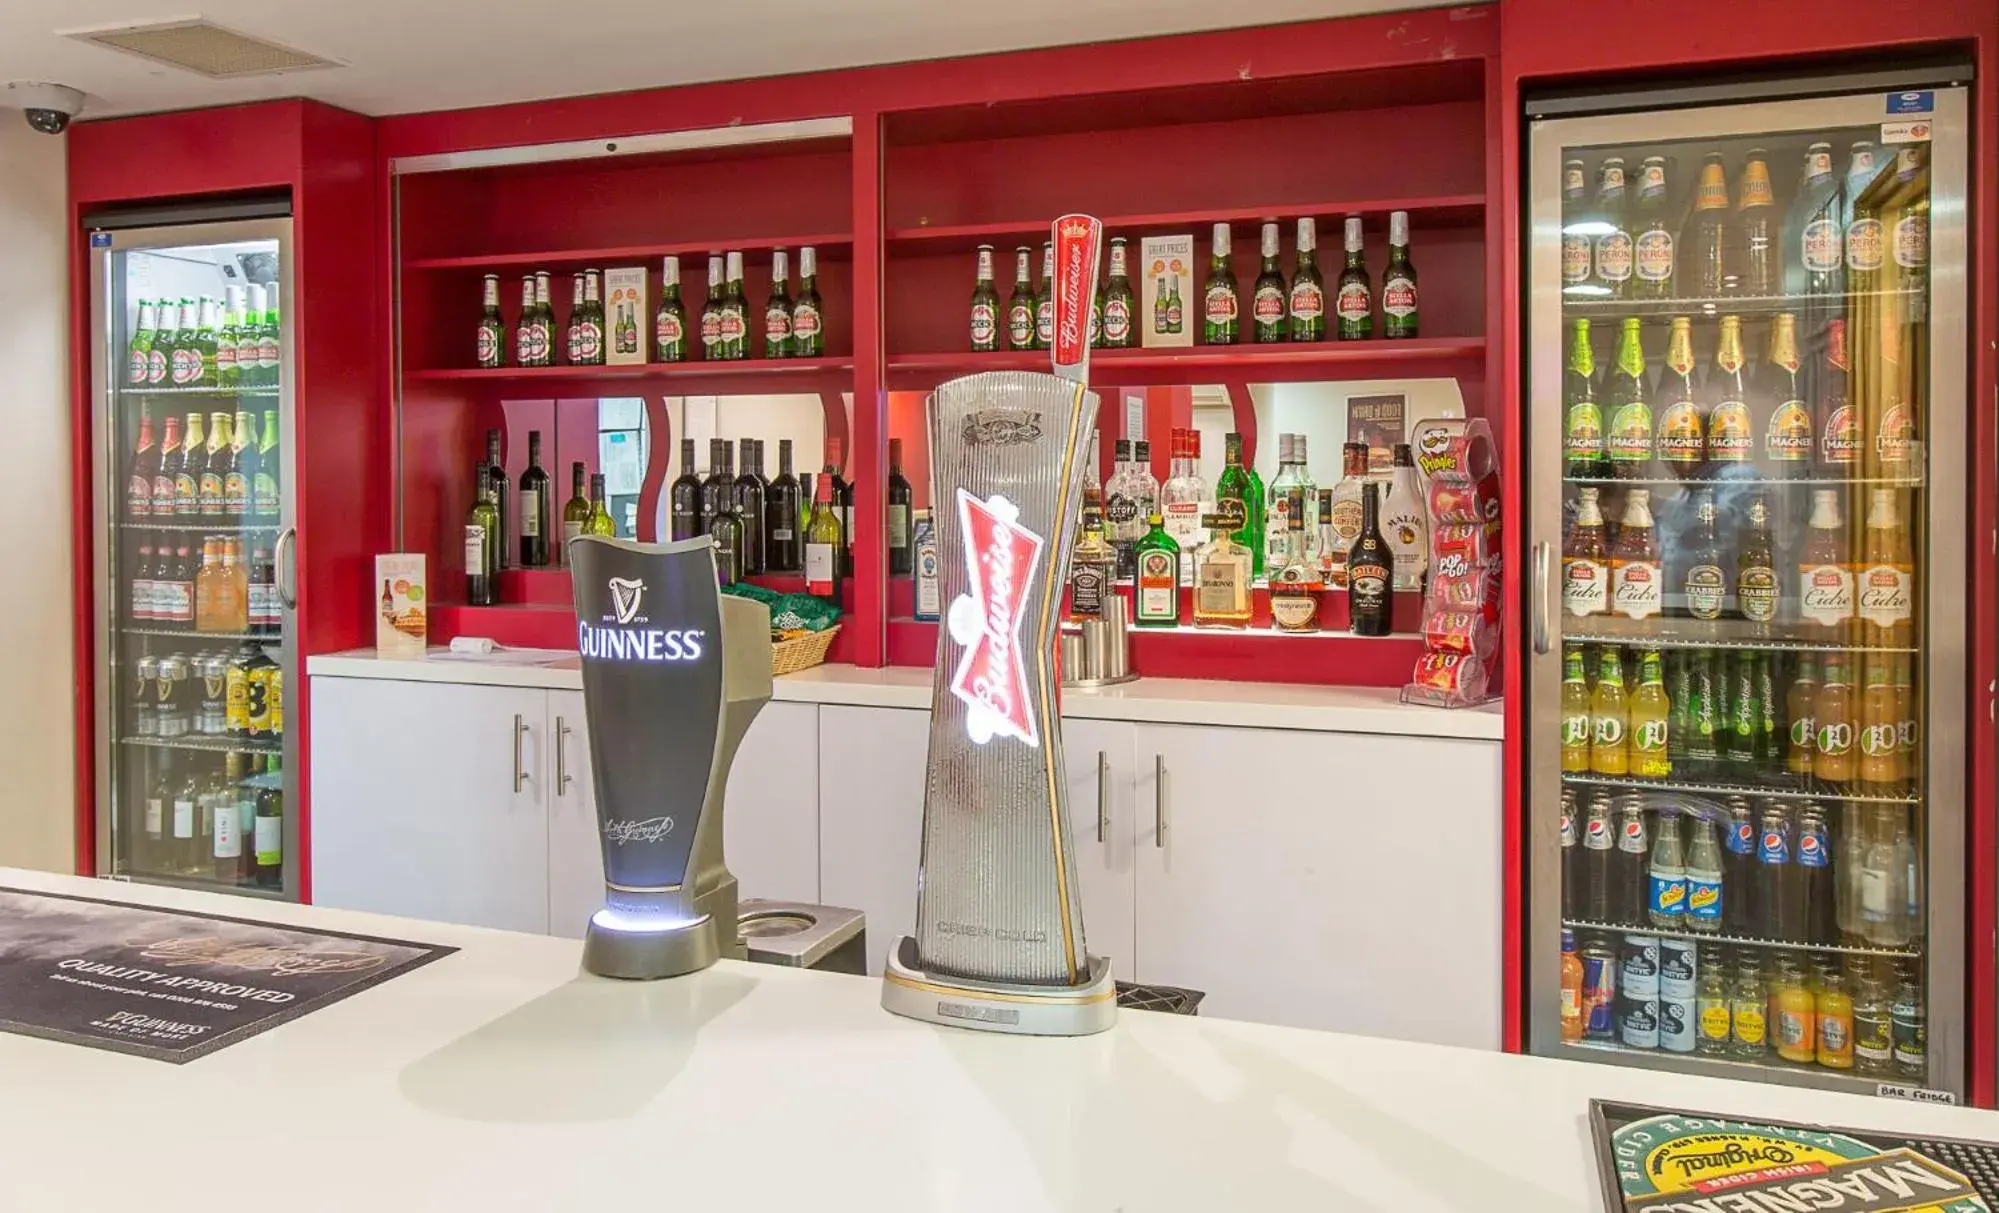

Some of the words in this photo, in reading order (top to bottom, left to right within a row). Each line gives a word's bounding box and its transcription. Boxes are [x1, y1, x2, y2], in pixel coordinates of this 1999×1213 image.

[1060, 243, 1083, 349] Budweiser
[1562, 581, 1602, 598] Cidre
[1616, 584, 1658, 600] Cidre
[1805, 588, 1850, 606] Cidre
[1861, 588, 1908, 606] Cidre
[973, 519, 1015, 719] Budweise
[579, 621, 702, 660] GUINNESS
[58, 959, 167, 984] QUALITY
[154, 975, 296, 1004] APPROVED
[1881, 1086, 1905, 1097] BAR
[1913, 1090, 1952, 1103] FRIDGE
[1618, 1131, 1653, 1182] CIDER
[1667, 1143, 1794, 1177] Original
[1705, 1171, 1755, 1187] CIDER
[1765, 1163, 1814, 1178] IRISH
